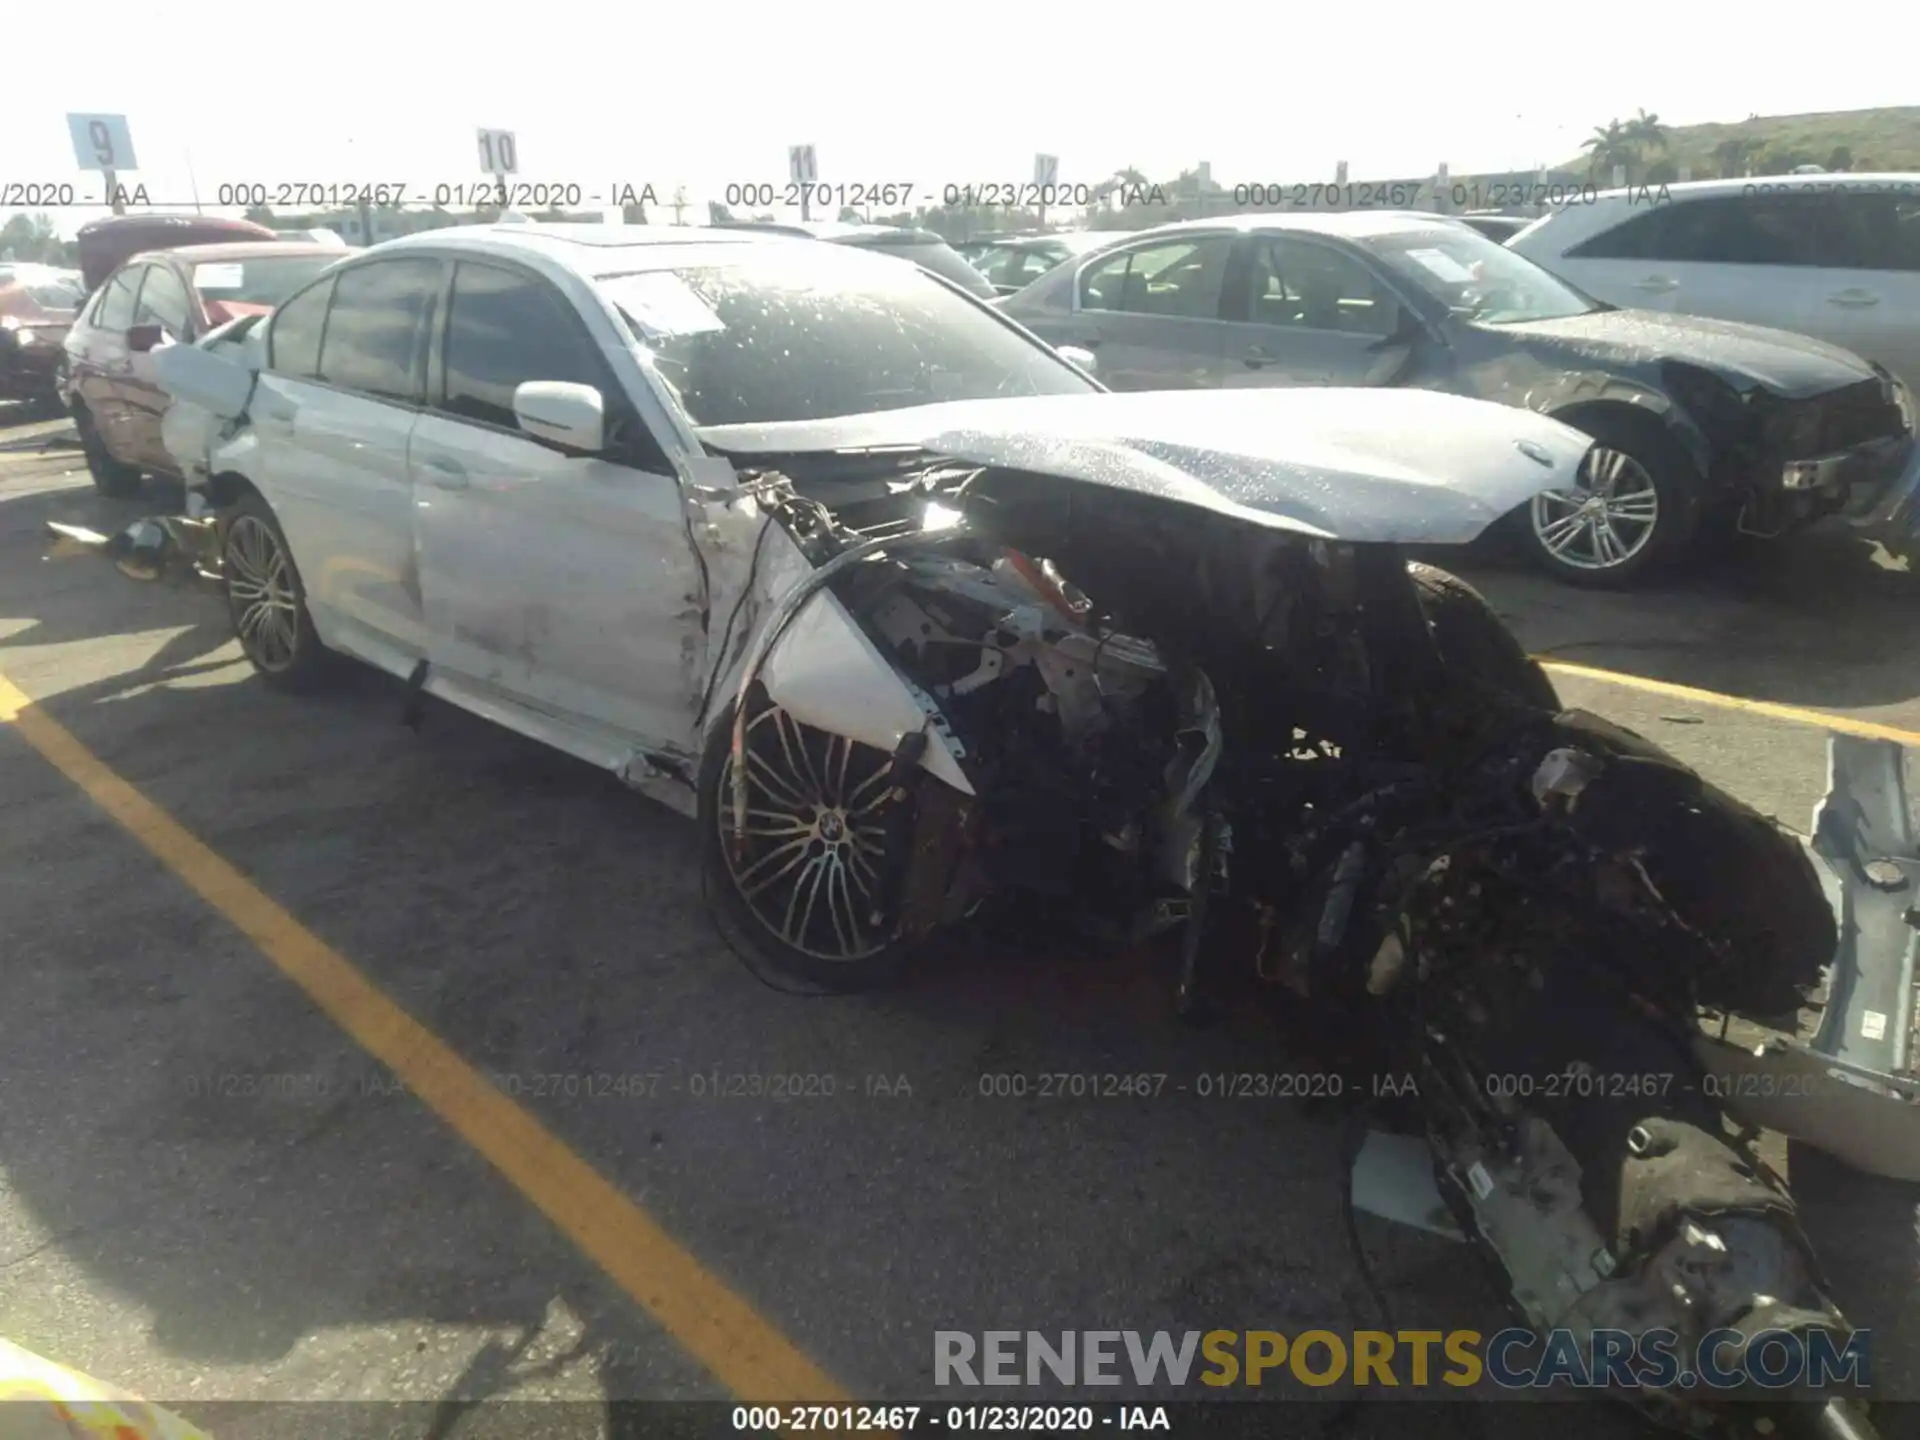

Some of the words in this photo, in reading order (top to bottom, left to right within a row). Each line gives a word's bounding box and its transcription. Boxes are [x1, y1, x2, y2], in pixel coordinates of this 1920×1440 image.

[88, 119, 115, 166] 9
[478, 131, 514, 172] 10
[790, 144, 814, 180] 11
